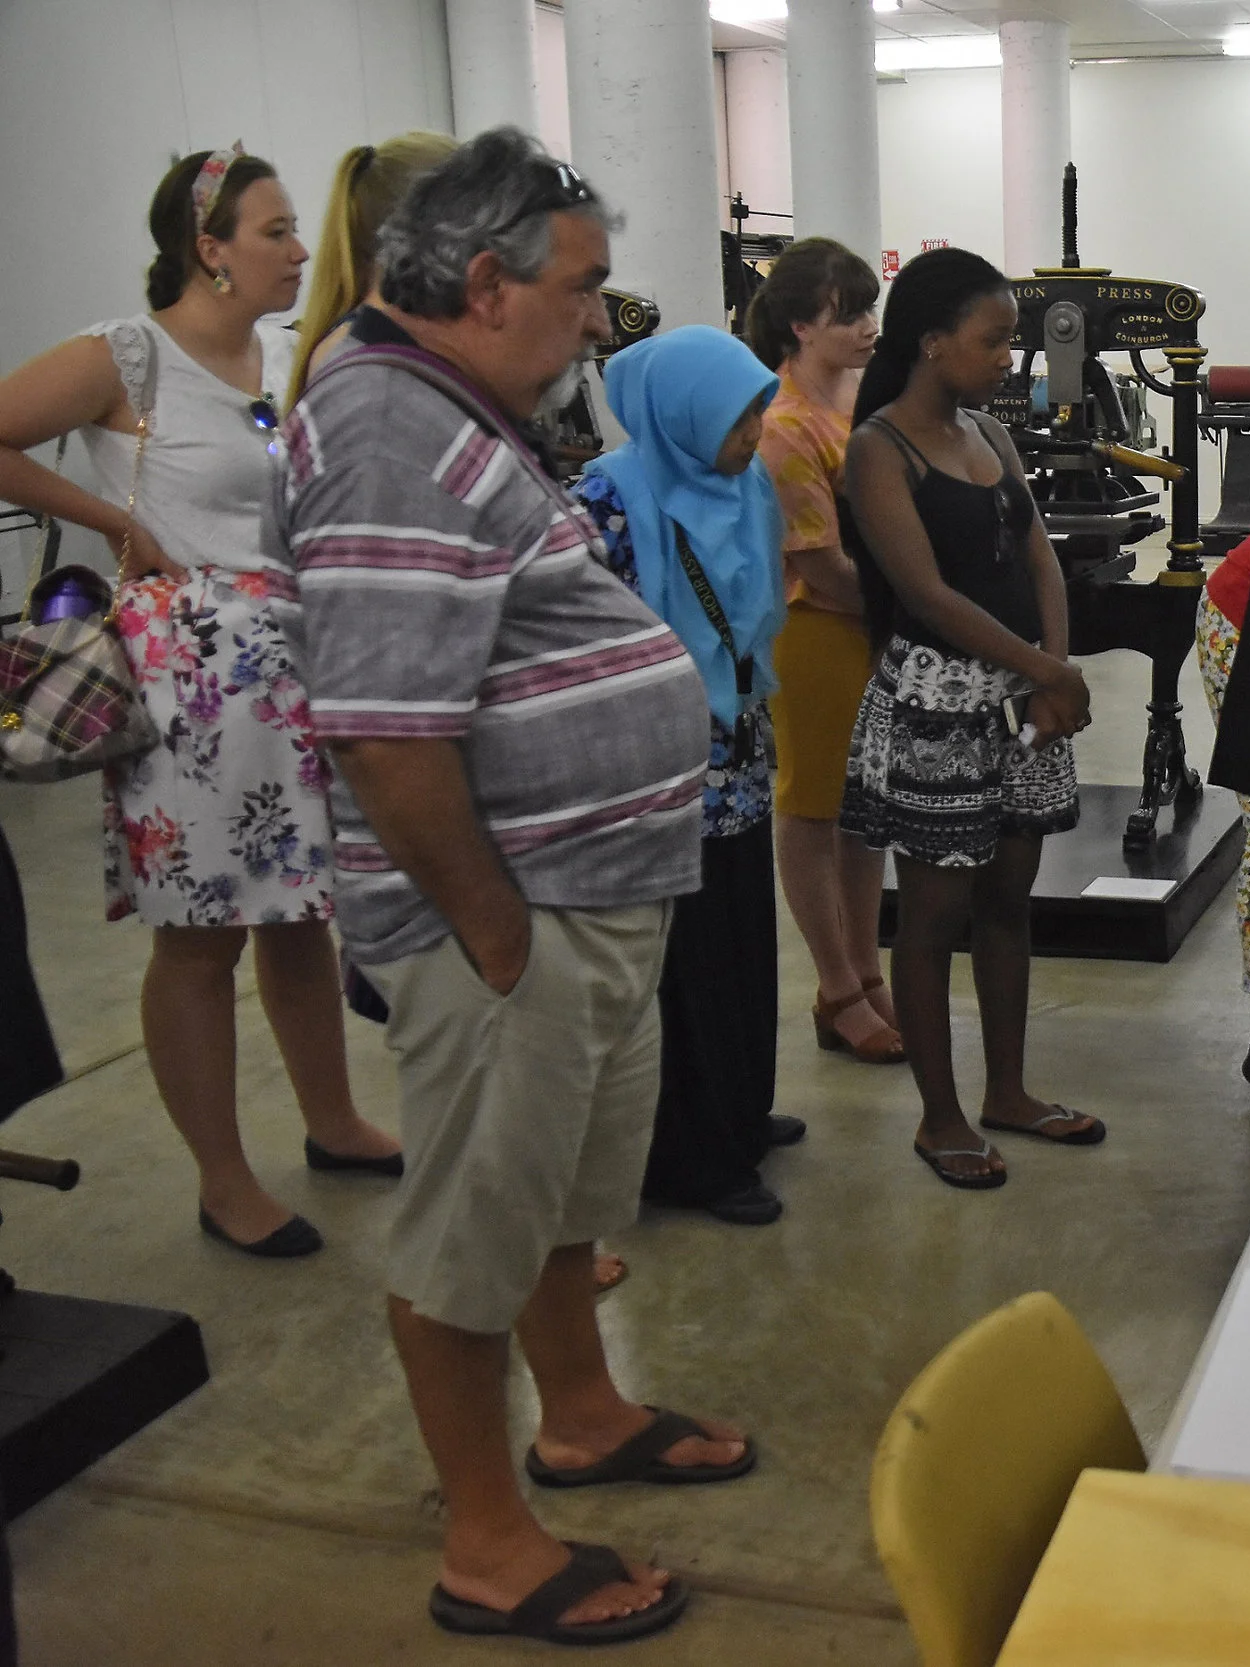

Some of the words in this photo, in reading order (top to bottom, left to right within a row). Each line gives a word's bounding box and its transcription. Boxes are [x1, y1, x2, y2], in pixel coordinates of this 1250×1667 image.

[1015, 287, 1046, 299] ION
[1097, 286, 1153, 300] PRESS
[1121, 315, 1163, 324] LONDON
[1115, 332, 1169, 343] EDINBURGH
